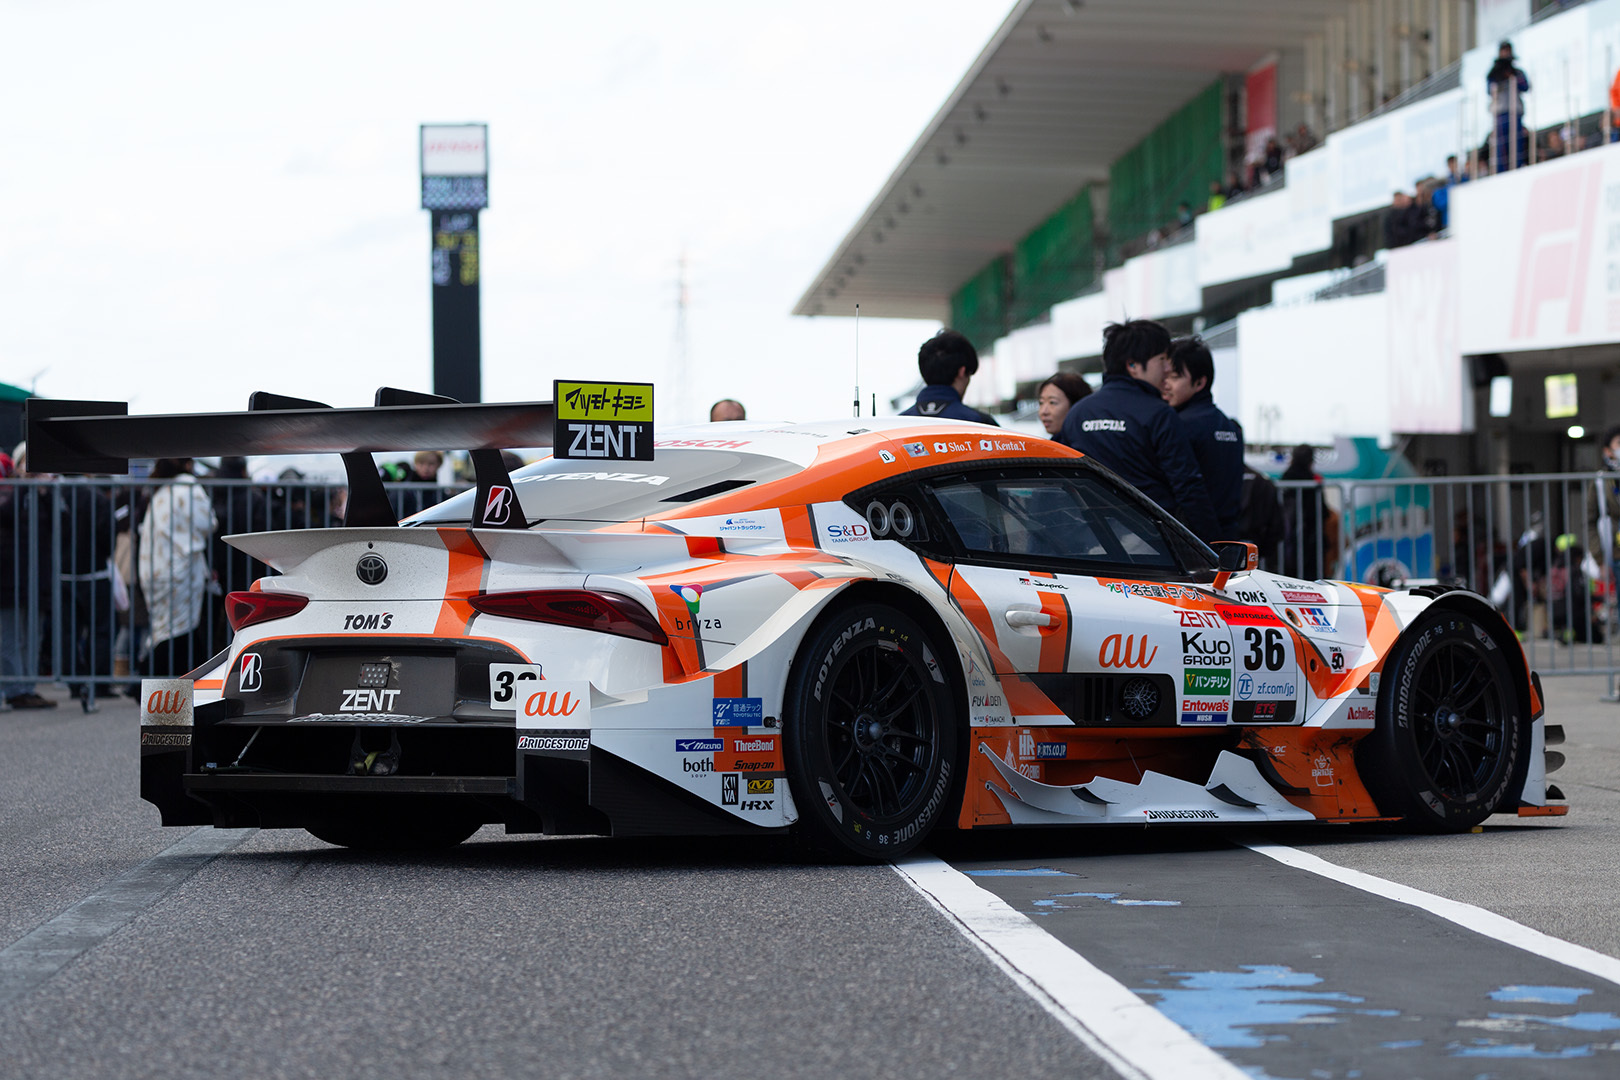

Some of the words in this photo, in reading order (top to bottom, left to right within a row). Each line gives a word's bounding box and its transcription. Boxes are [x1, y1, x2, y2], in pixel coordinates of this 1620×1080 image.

[565, 387, 646, 416] マツモトキヨシ
[1082, 420, 1126, 431] OFFICIAL
[654, 440, 752, 449] OSCH
[948, 441, 973, 452] Sho.T
[994, 440, 1026, 452] Kenta.Y
[513, 472, 670, 486] OTENZA
[827, 525, 867, 536] S&D
[1235, 591, 1268, 603] TOM'S
[344, 612, 394, 630] TOM'S
[1173, 610, 1221, 628] ZENT
[1233, 612, 1276, 620] AUTOBACS
[675, 618, 722, 632] bryza
[1099, 634, 1158, 668] au
[1244, 627, 1285, 671] 36
[813, 617, 876, 702] POTENZA
[1183, 655, 1232, 665] GROUP
[494, 671, 537, 702] 3
[1195, 676, 1230, 688] バンテリン
[1257, 682, 1295, 696] zf.com/jp
[147, 690, 186, 714] au
[339, 690, 401, 711] ZENT
[524, 691, 580, 716] au
[1182, 700, 1229, 711] Entowa's
[733, 704, 761, 712] 豊通テック
[1255, 703, 1276, 714] ETS
[1347, 707, 1375, 720] Achilles
[142, 734, 192, 745] BRIDGESTONE
[518, 737, 589, 750] BRIDGESTONE
[734, 739, 774, 752] ThreeBond
[733, 760, 774, 771] Snap-on
[1311, 769, 1334, 777] BRIDE
[741, 801, 774, 810] HRX
[1144, 810, 1219, 819] BRIDGESTONE
